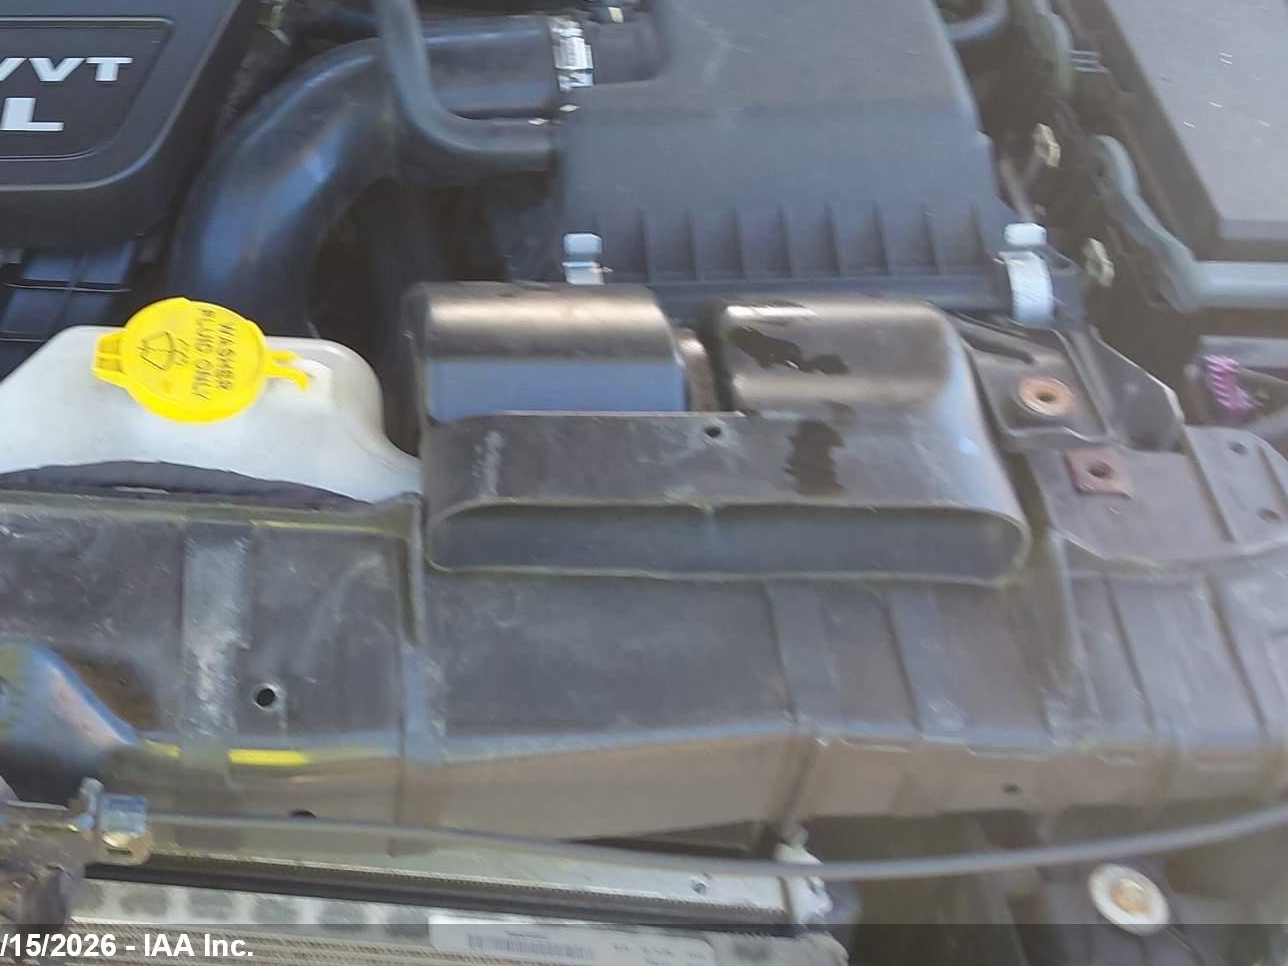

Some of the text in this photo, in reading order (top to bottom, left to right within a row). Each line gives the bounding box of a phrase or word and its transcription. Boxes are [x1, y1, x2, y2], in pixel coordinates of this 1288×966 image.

[0, 97, 65, 132] L
[191, 308, 216, 401] FLUID ONLY
[215, 321, 237, 391] WASHER
